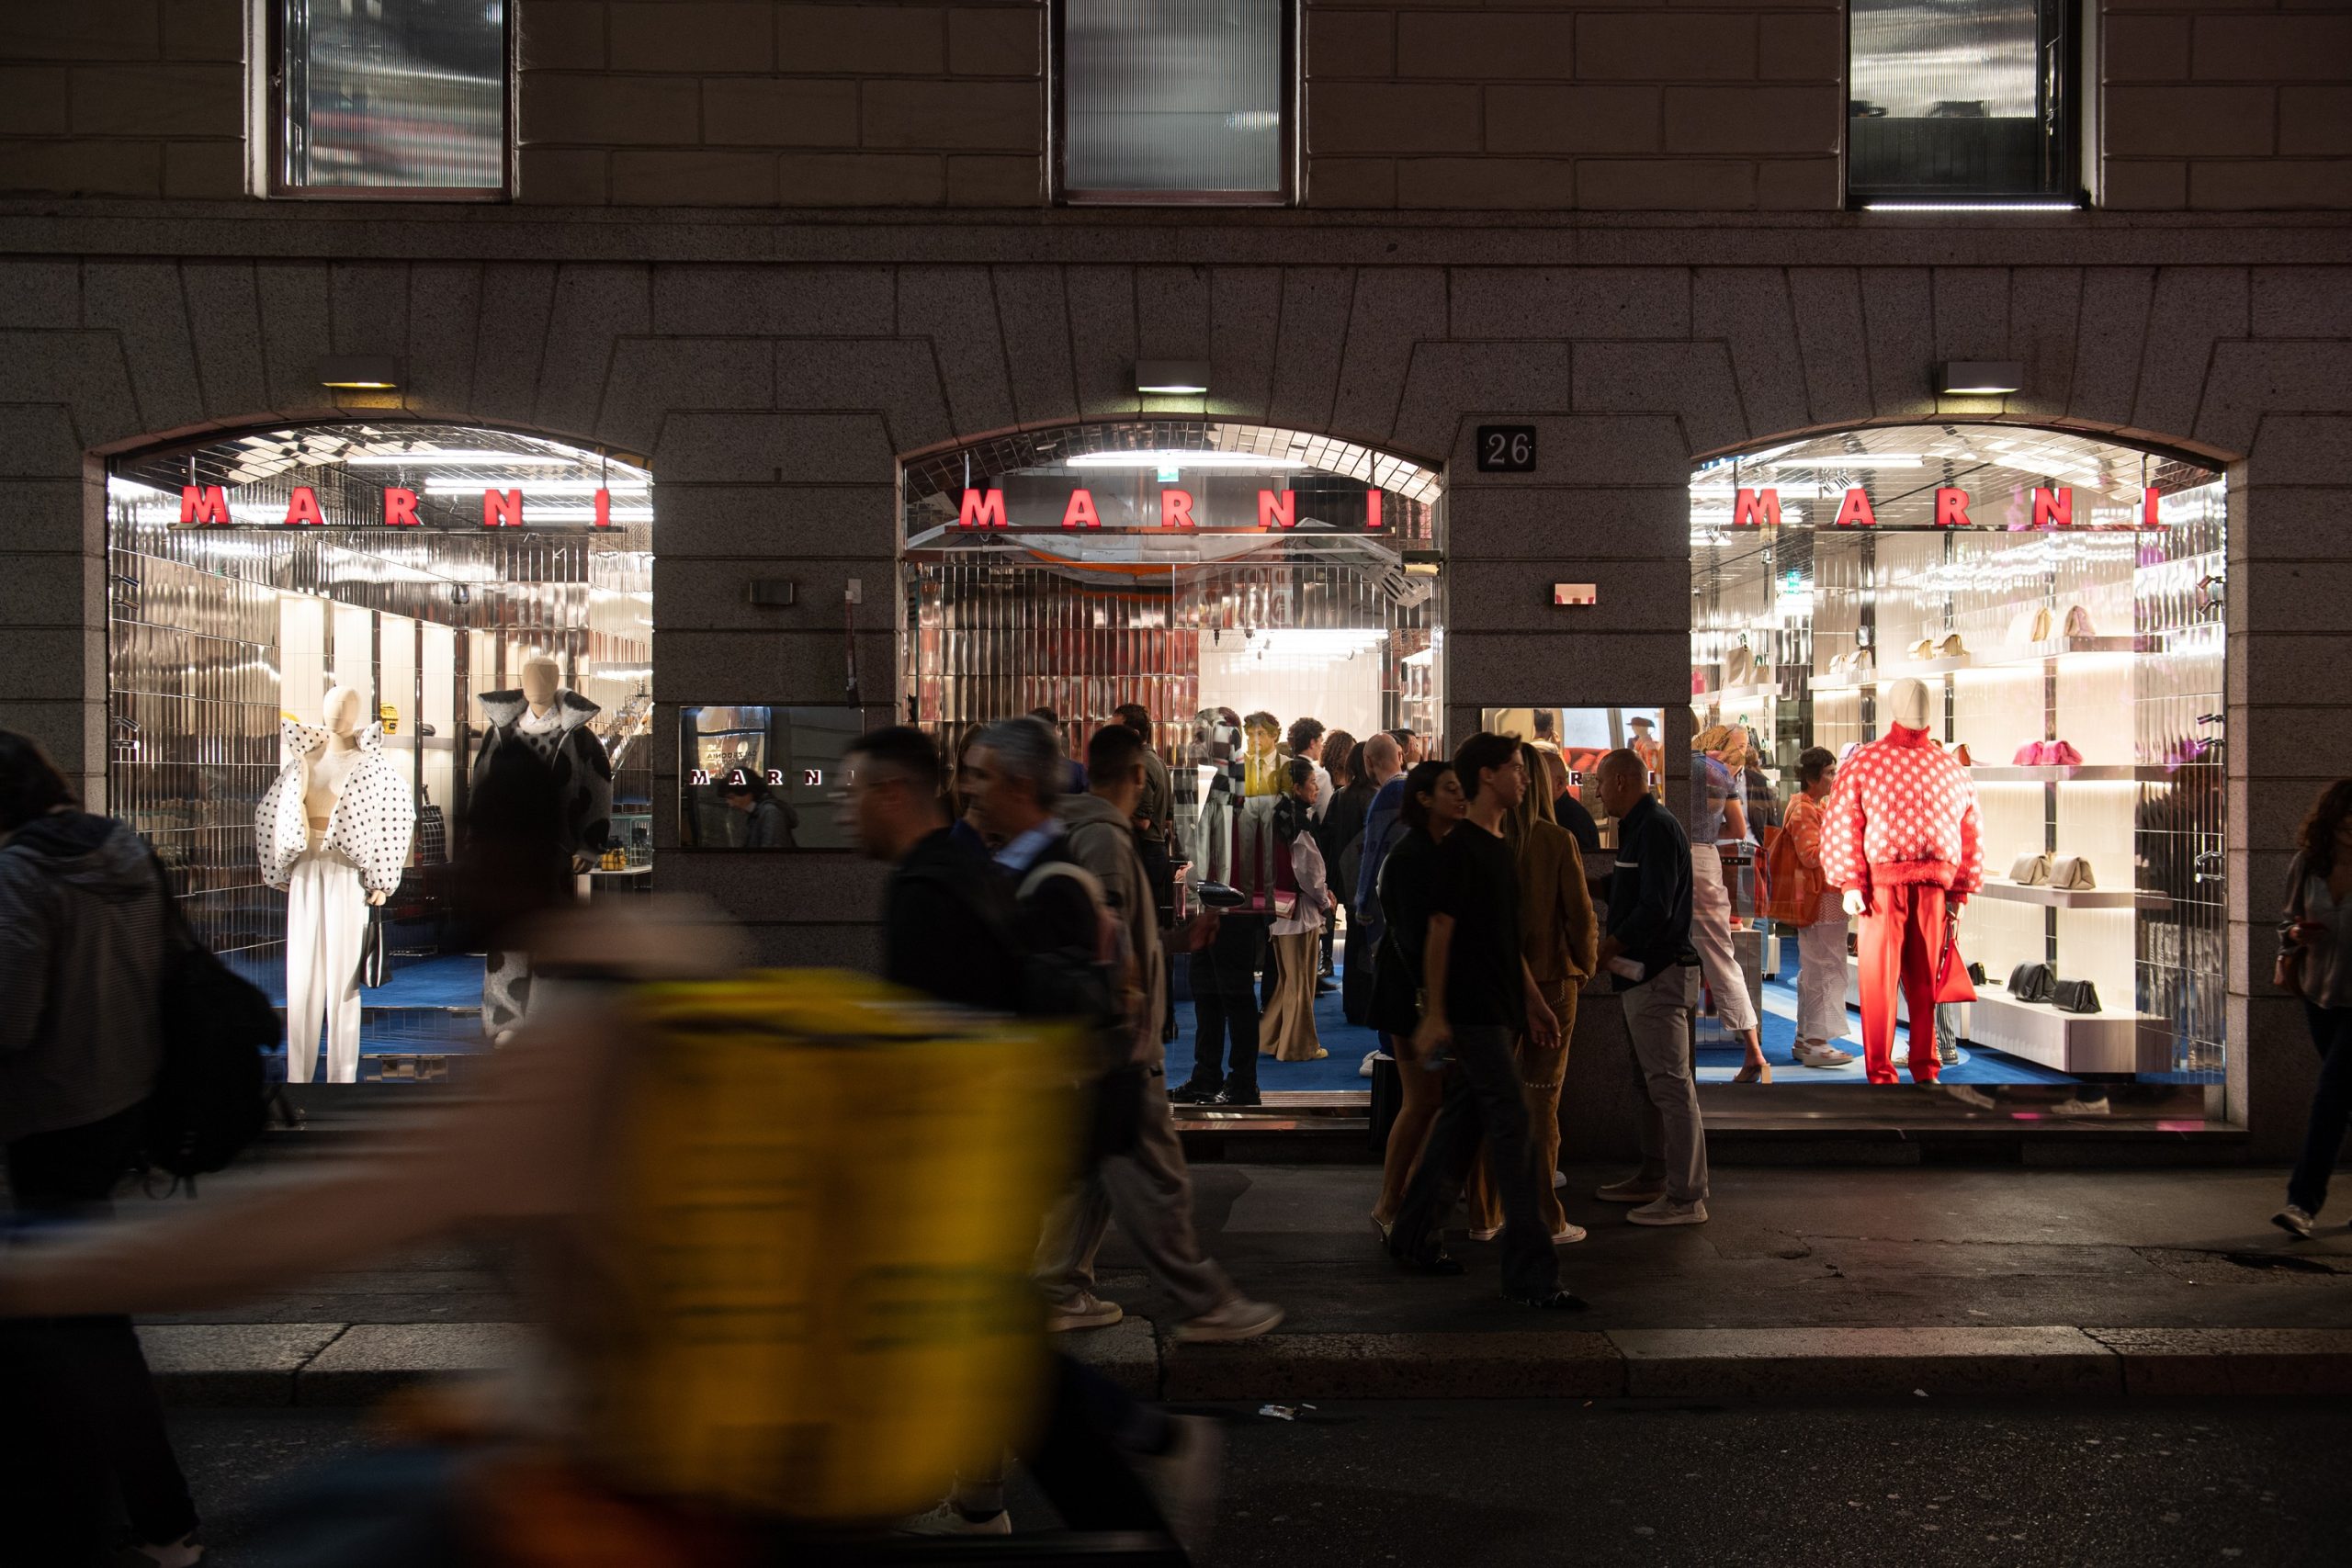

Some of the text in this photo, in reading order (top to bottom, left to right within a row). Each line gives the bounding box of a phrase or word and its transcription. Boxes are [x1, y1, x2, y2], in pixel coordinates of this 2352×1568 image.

[1487, 434, 1529, 464] 26
[181, 486, 611, 525] MARNI
[959, 489, 1382, 527] MARNI
[1735, 488, 2159, 525] MARNI
